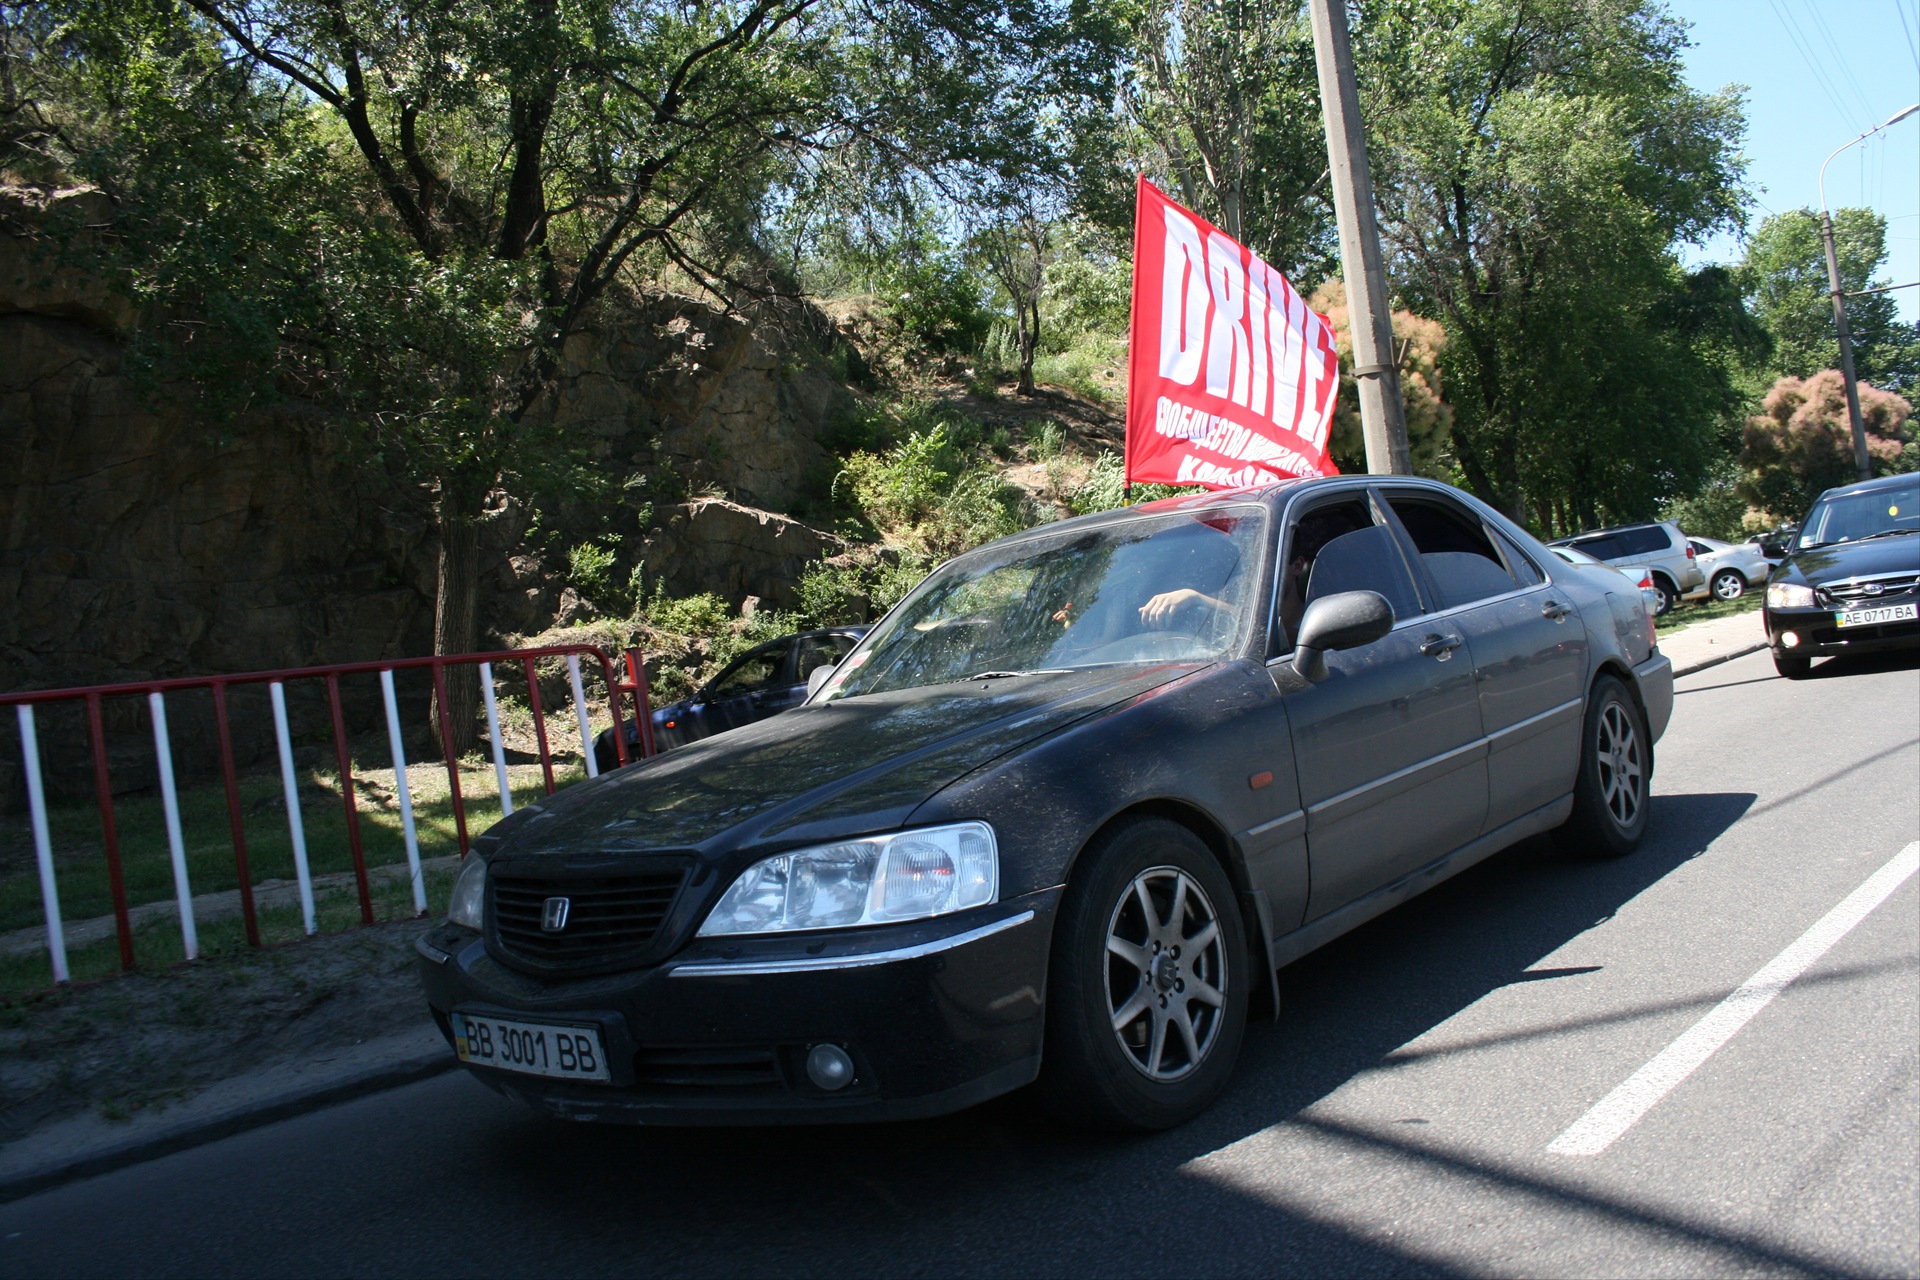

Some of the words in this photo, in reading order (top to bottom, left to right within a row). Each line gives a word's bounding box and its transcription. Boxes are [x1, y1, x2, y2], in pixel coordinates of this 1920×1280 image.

[1845, 612, 1861, 625] AE
[1864, 608, 1891, 622] 0717
[1895, 606, 1914, 619] BA
[465, 1021, 494, 1059] BB
[498, 1025, 549, 1068] 3001
[556, 1033, 597, 1073] BB
